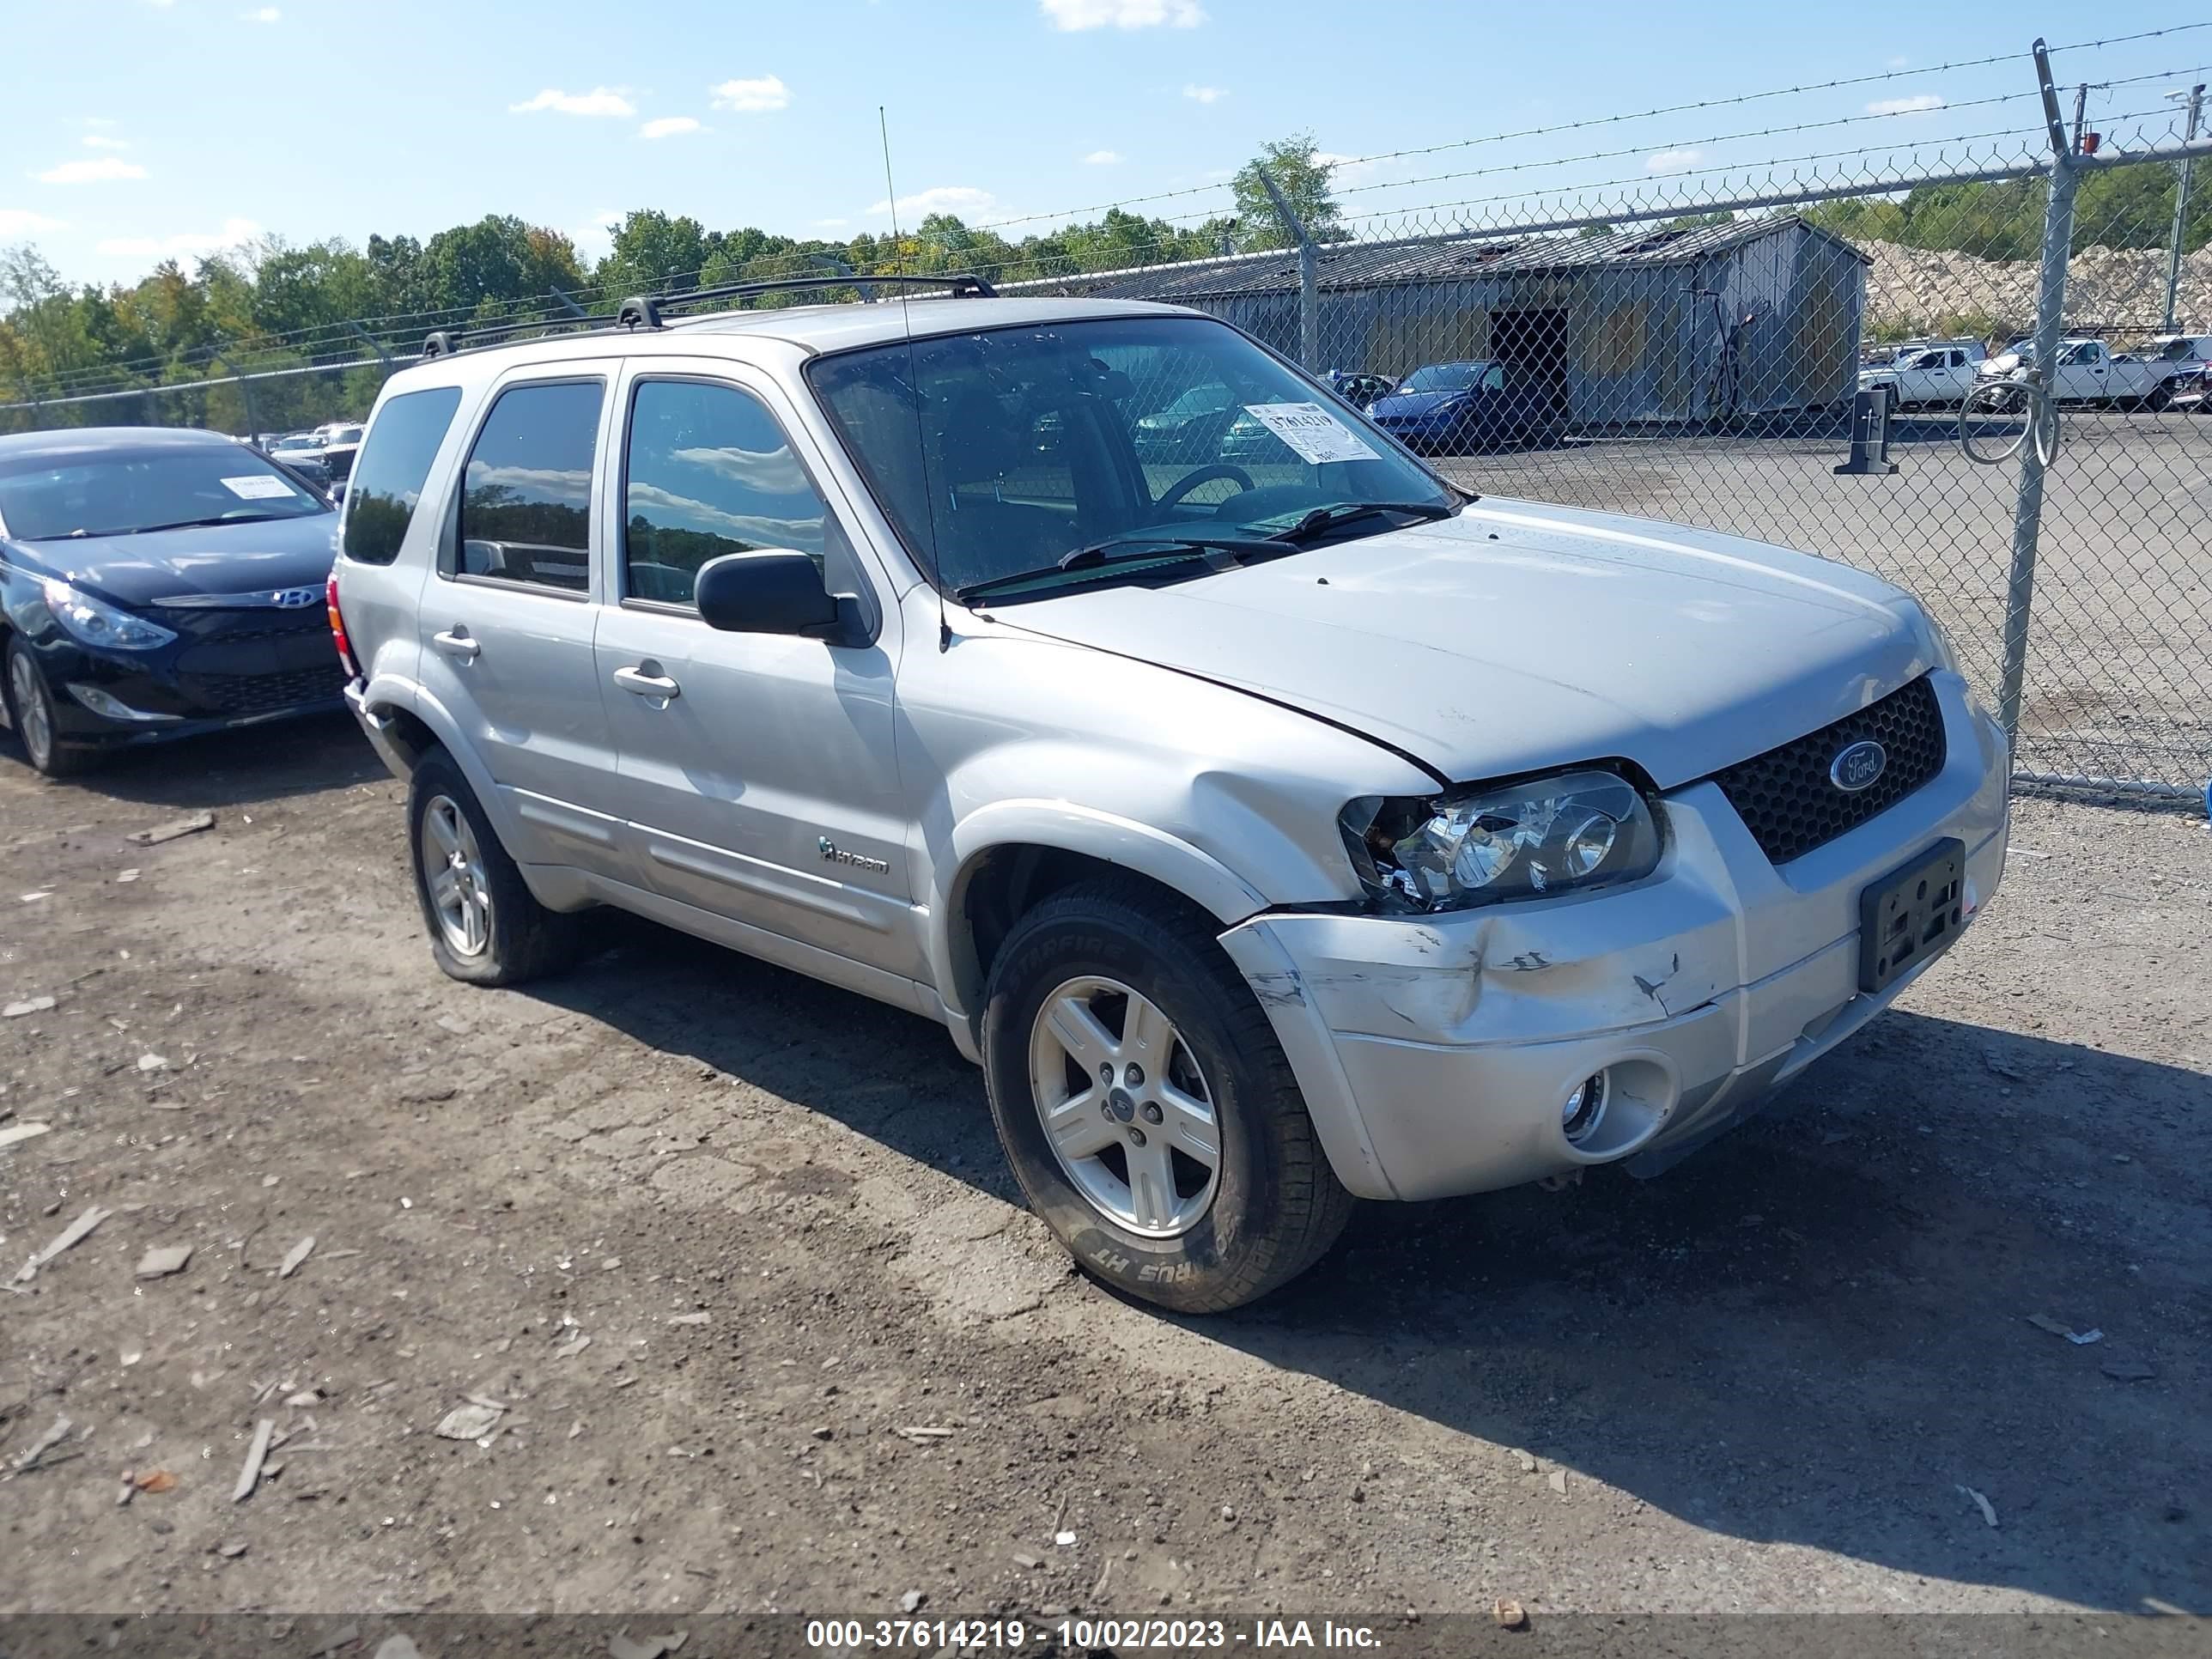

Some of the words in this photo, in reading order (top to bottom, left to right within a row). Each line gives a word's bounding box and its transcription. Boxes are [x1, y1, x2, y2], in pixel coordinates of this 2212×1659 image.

[1269, 416, 1332, 428] 37614219
[1848, 750, 1877, 782] Ford
[1090, 1249, 1129, 1273] HT
